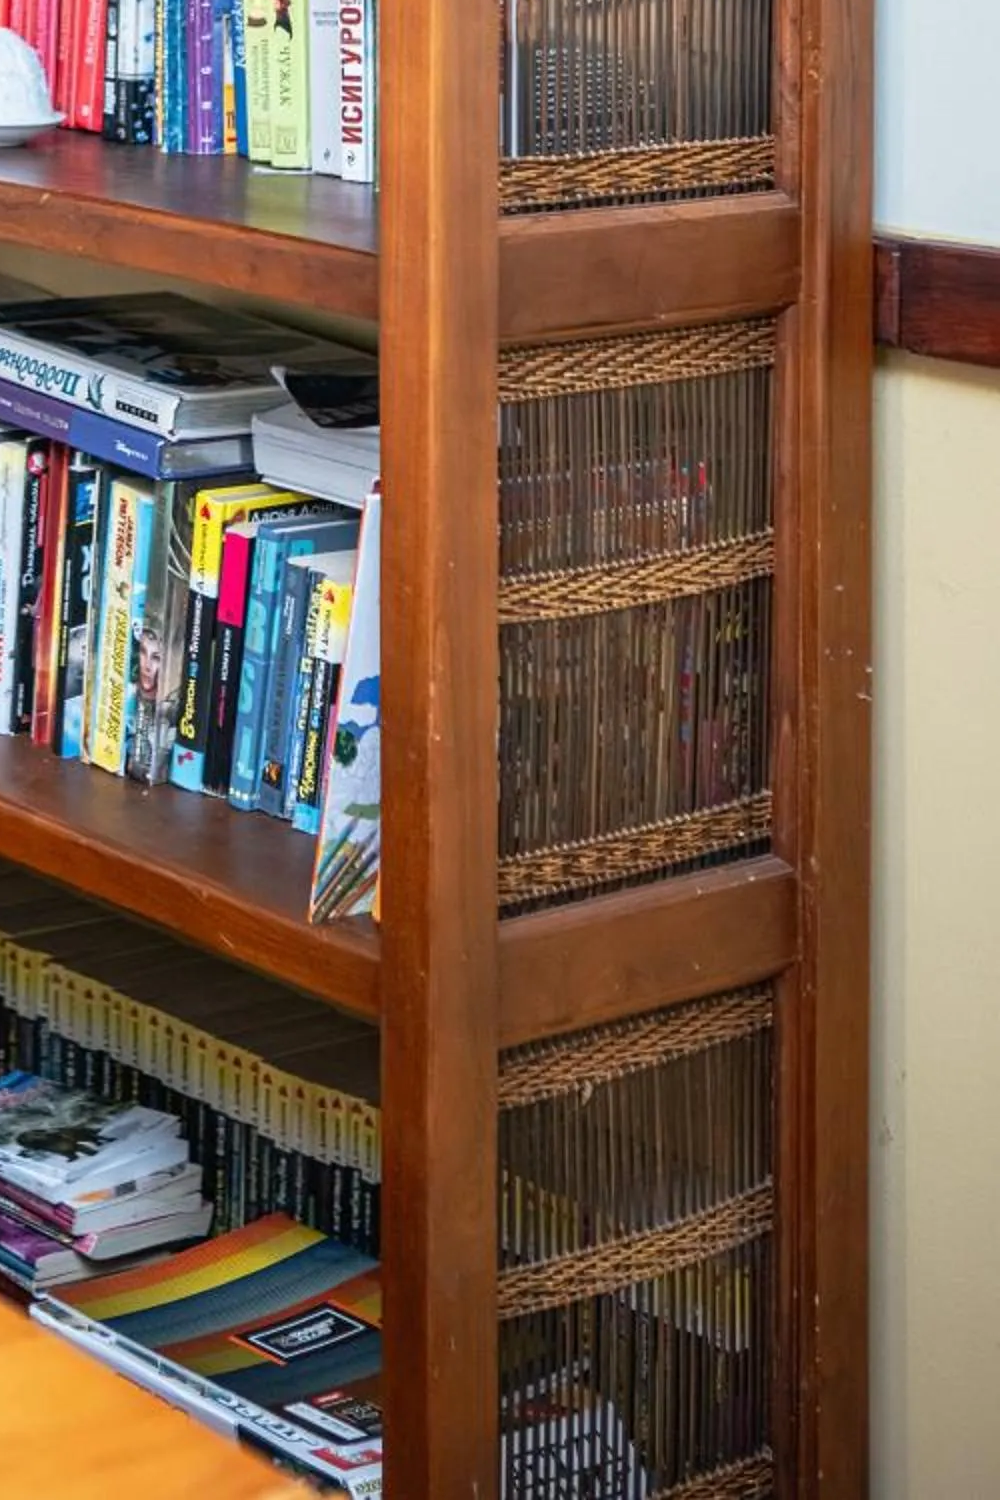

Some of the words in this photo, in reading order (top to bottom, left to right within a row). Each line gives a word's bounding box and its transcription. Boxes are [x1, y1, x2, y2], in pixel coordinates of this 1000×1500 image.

[279, 46, 292, 106] ЧУЖАК
[340, 7, 362, 145] ИСИГУРО
[115, 497, 128, 569] PATTERSON
[300, 502, 336, 518] ДОНЦ
[179, 678, 197, 740] Верхом
